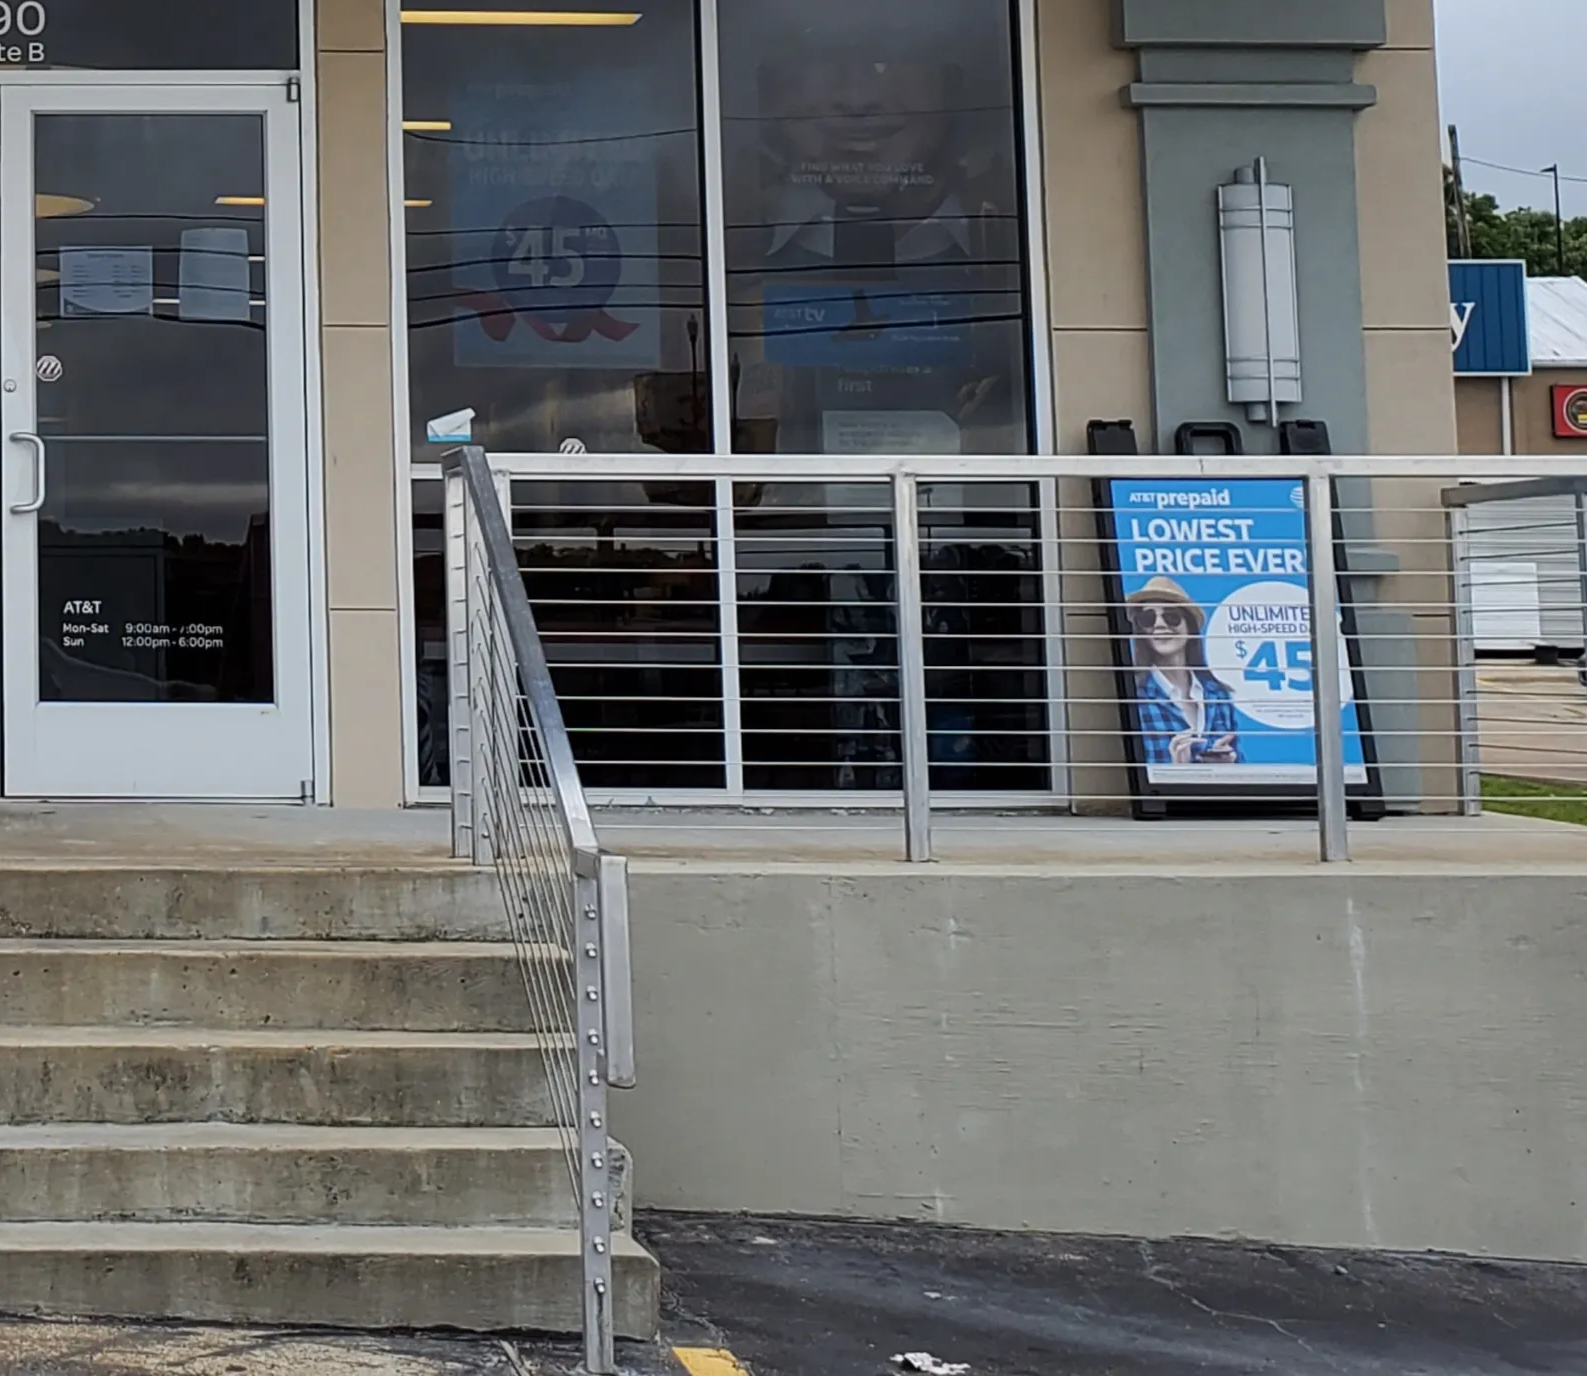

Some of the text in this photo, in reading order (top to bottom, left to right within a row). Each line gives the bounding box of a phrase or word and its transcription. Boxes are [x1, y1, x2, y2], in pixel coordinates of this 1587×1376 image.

[28, 42, 45, 62] B
[1157, 489, 1231, 510] prepaid
[1131, 518, 1254, 542] LOWEST
[1135, 548, 1222, 573] PRICE
[63, 600, 102, 614] AT&T
[1228, 606, 1309, 621] UNLIMITE
[63, 623, 109, 634] Mon-Sat
[125, 623, 170, 634] 9:00am
[1228, 623, 1298, 634] HIGH-SPEED
[63, 636, 84, 647] Sun
[122, 636, 170, 649] 12:00pm
[178, 636, 223, 649] 6:00pm
